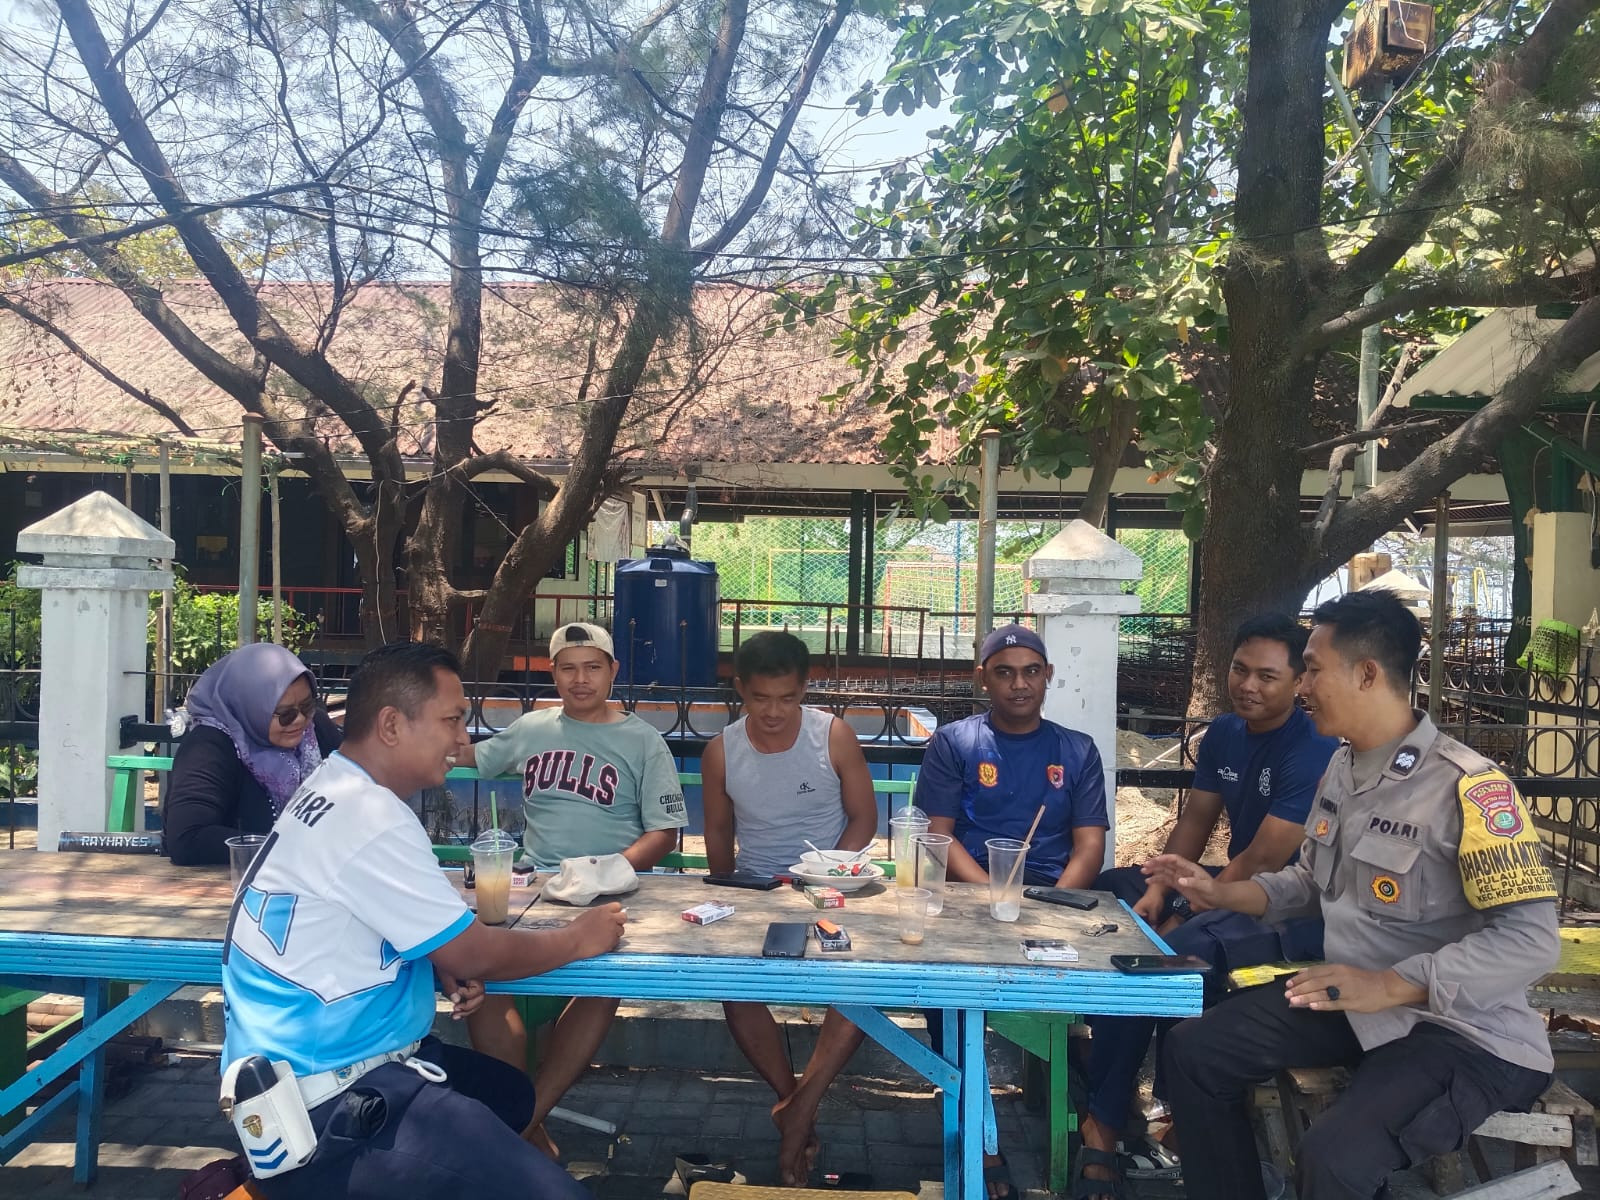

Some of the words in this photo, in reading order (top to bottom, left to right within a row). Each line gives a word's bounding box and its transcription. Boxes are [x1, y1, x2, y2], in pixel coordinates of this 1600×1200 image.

[524, 750, 619, 807] BULLS
[666, 802, 684, 814] BULLS
[1370, 817, 1418, 839] POLRI
[81, 835, 149, 847] RAYHAYES
[1476, 872, 1517, 887] PULAU
[1479, 885, 1500, 895] KEL.
[1502, 877, 1534, 889] PULAU
[1497, 889, 1516, 900] KEP.
